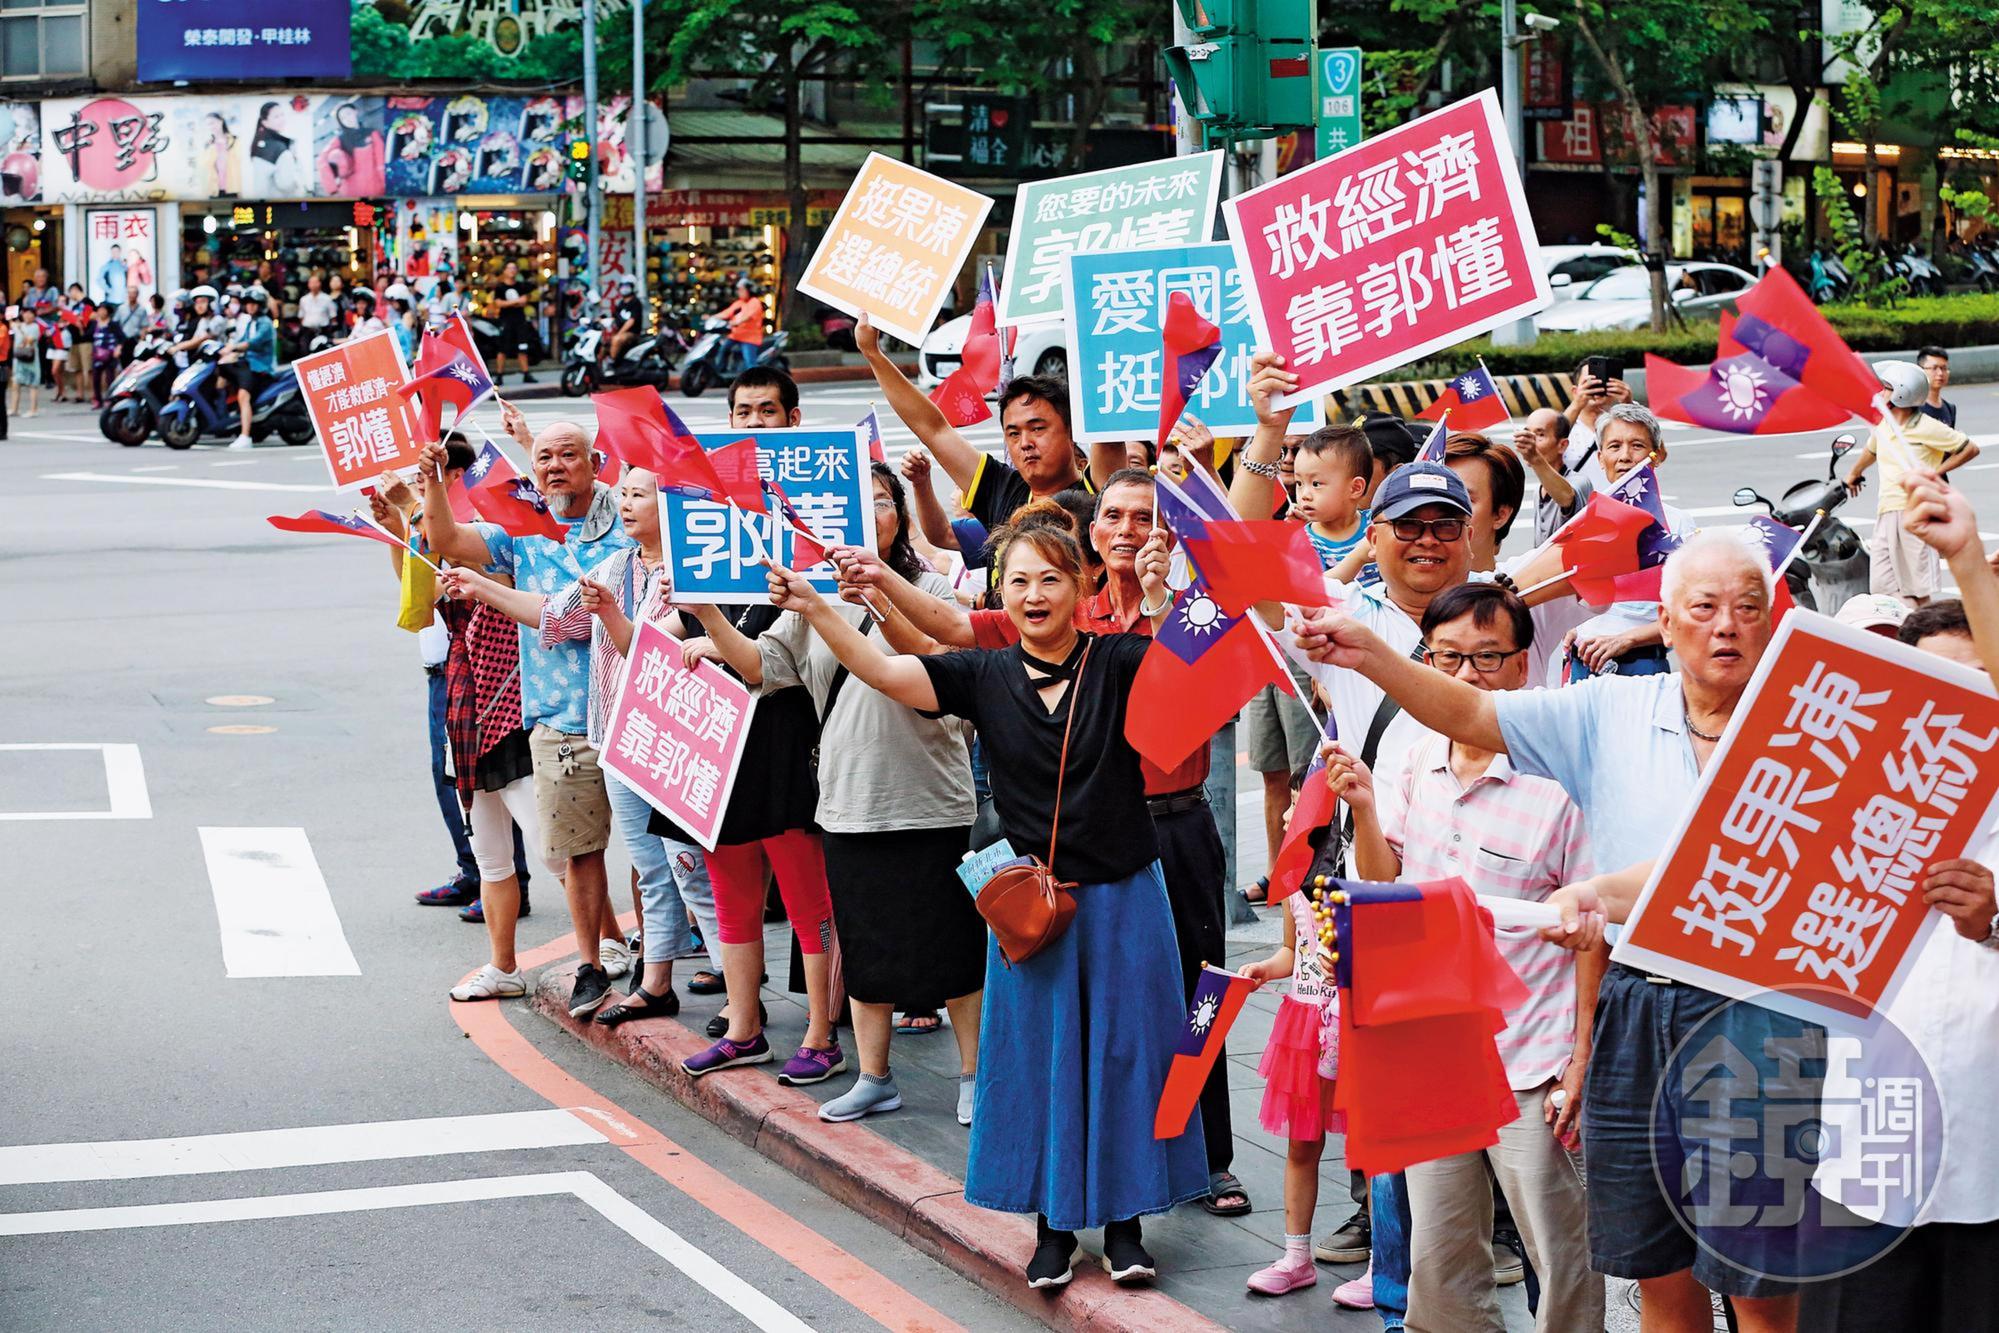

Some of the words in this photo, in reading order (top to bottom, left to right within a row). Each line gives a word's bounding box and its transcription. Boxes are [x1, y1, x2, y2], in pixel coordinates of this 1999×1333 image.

[1327, 99, 1349, 113] 106
[1335, 59, 1346, 83] 3
[52, 110, 170, 182] 中野
[94, 213, 150, 241] 雨衣
[850, 174, 968, 256] 挺果凍
[1033, 170, 1201, 224] 您要的未來
[1262, 129, 1481, 280] 救經濟
[817, 228, 940, 317] 選總統
[1285, 215, 1513, 368] 靠郭懂
[682, 492, 849, 581] 郭懂
[633, 646, 740, 754] 救經濟
[615, 707, 722, 820] 靠郭懂
[1671, 660, 1893, 958] 挺果凍
[1774, 699, 1999, 995] 選總統
[1297, 984, 1319, 996] Hello
